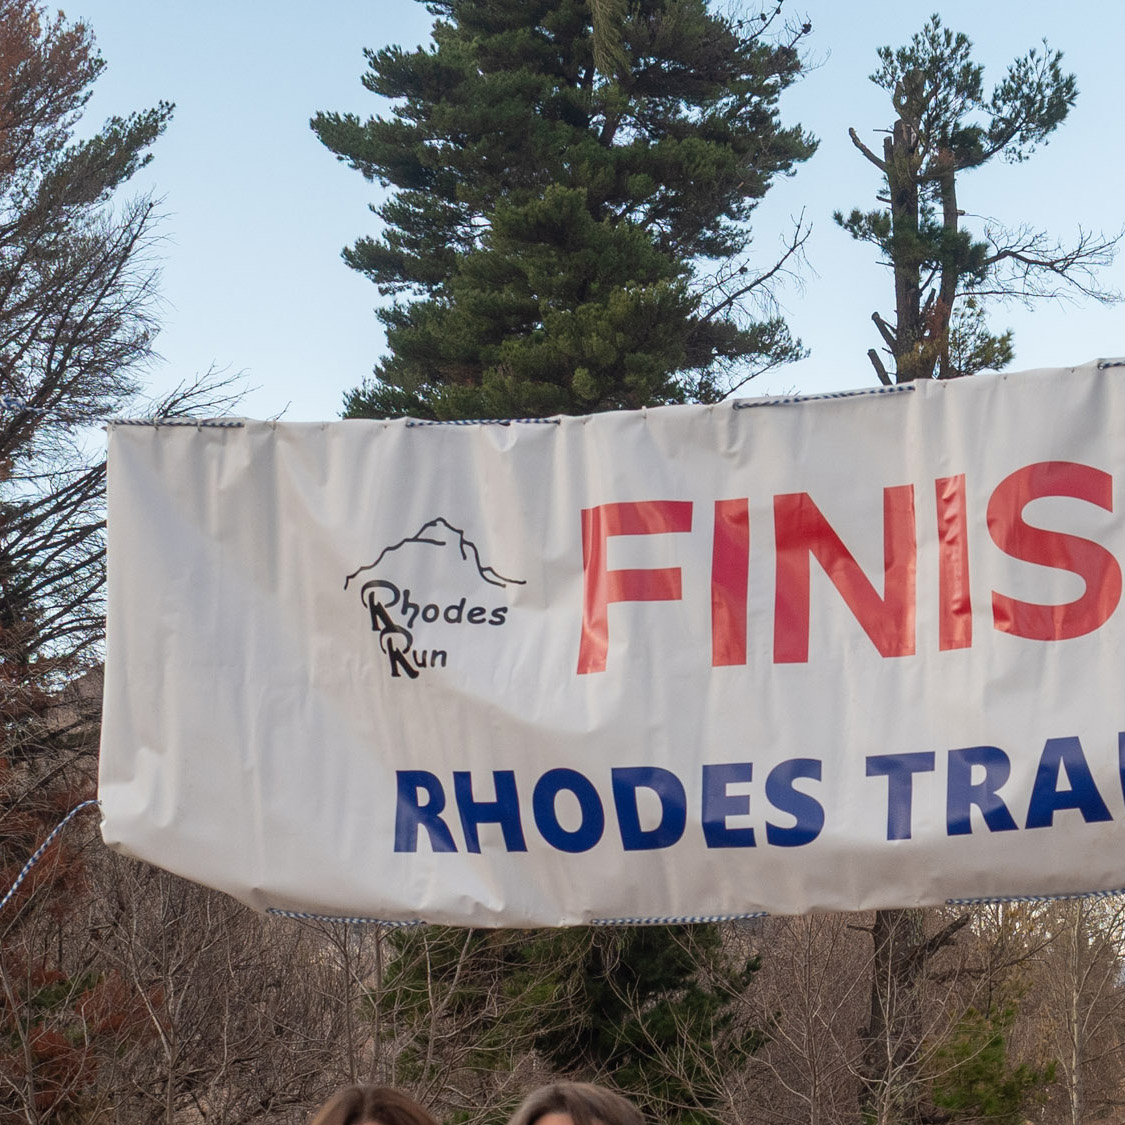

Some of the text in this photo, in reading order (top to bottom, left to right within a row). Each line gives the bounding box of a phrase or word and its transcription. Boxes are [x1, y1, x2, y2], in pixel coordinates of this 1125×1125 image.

[360, 579, 508, 632] Rhodes
[379, 626, 448, 679] Run
[394, 758, 826, 854] RHODES
